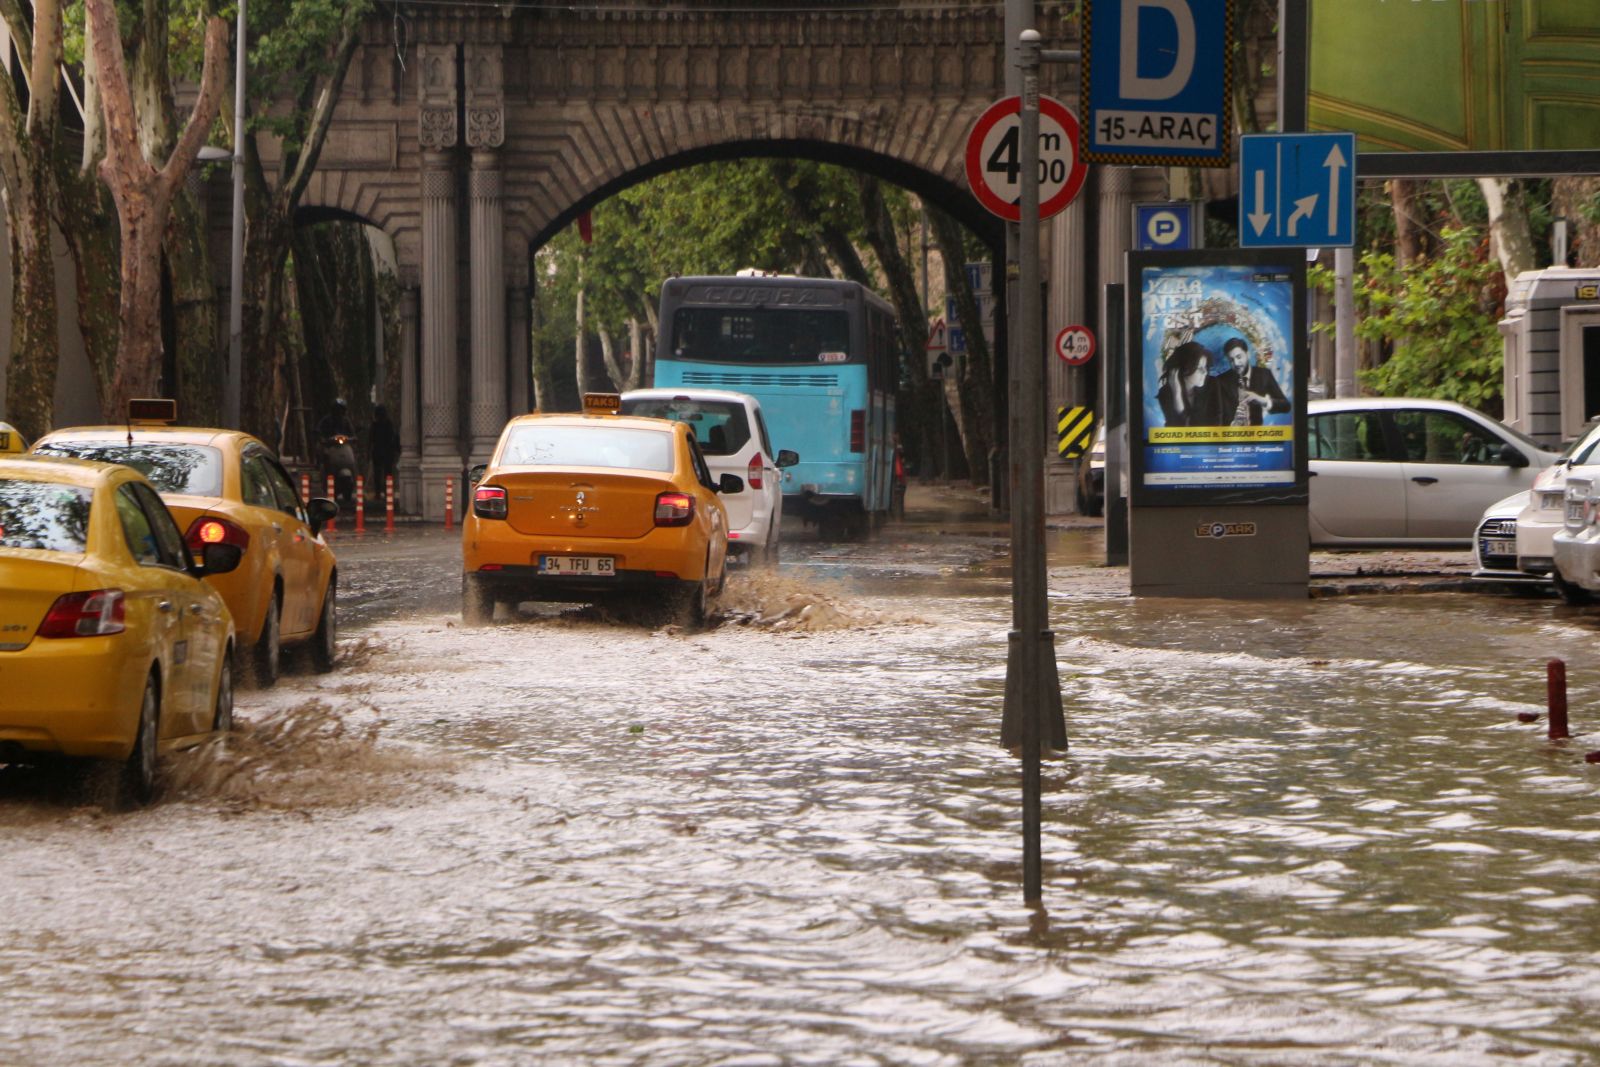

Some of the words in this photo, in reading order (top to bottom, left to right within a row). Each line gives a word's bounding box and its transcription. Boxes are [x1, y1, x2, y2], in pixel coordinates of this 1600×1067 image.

[1119, 0, 1196, 100] D
[987, 126, 1021, 185] 4
[1156, 220, 1175, 237] P
[1063, 334, 1075, 354] 4
[548, 557, 560, 570] 34
[569, 558, 589, 571] TFU
[598, 559, 611, 571] 65
